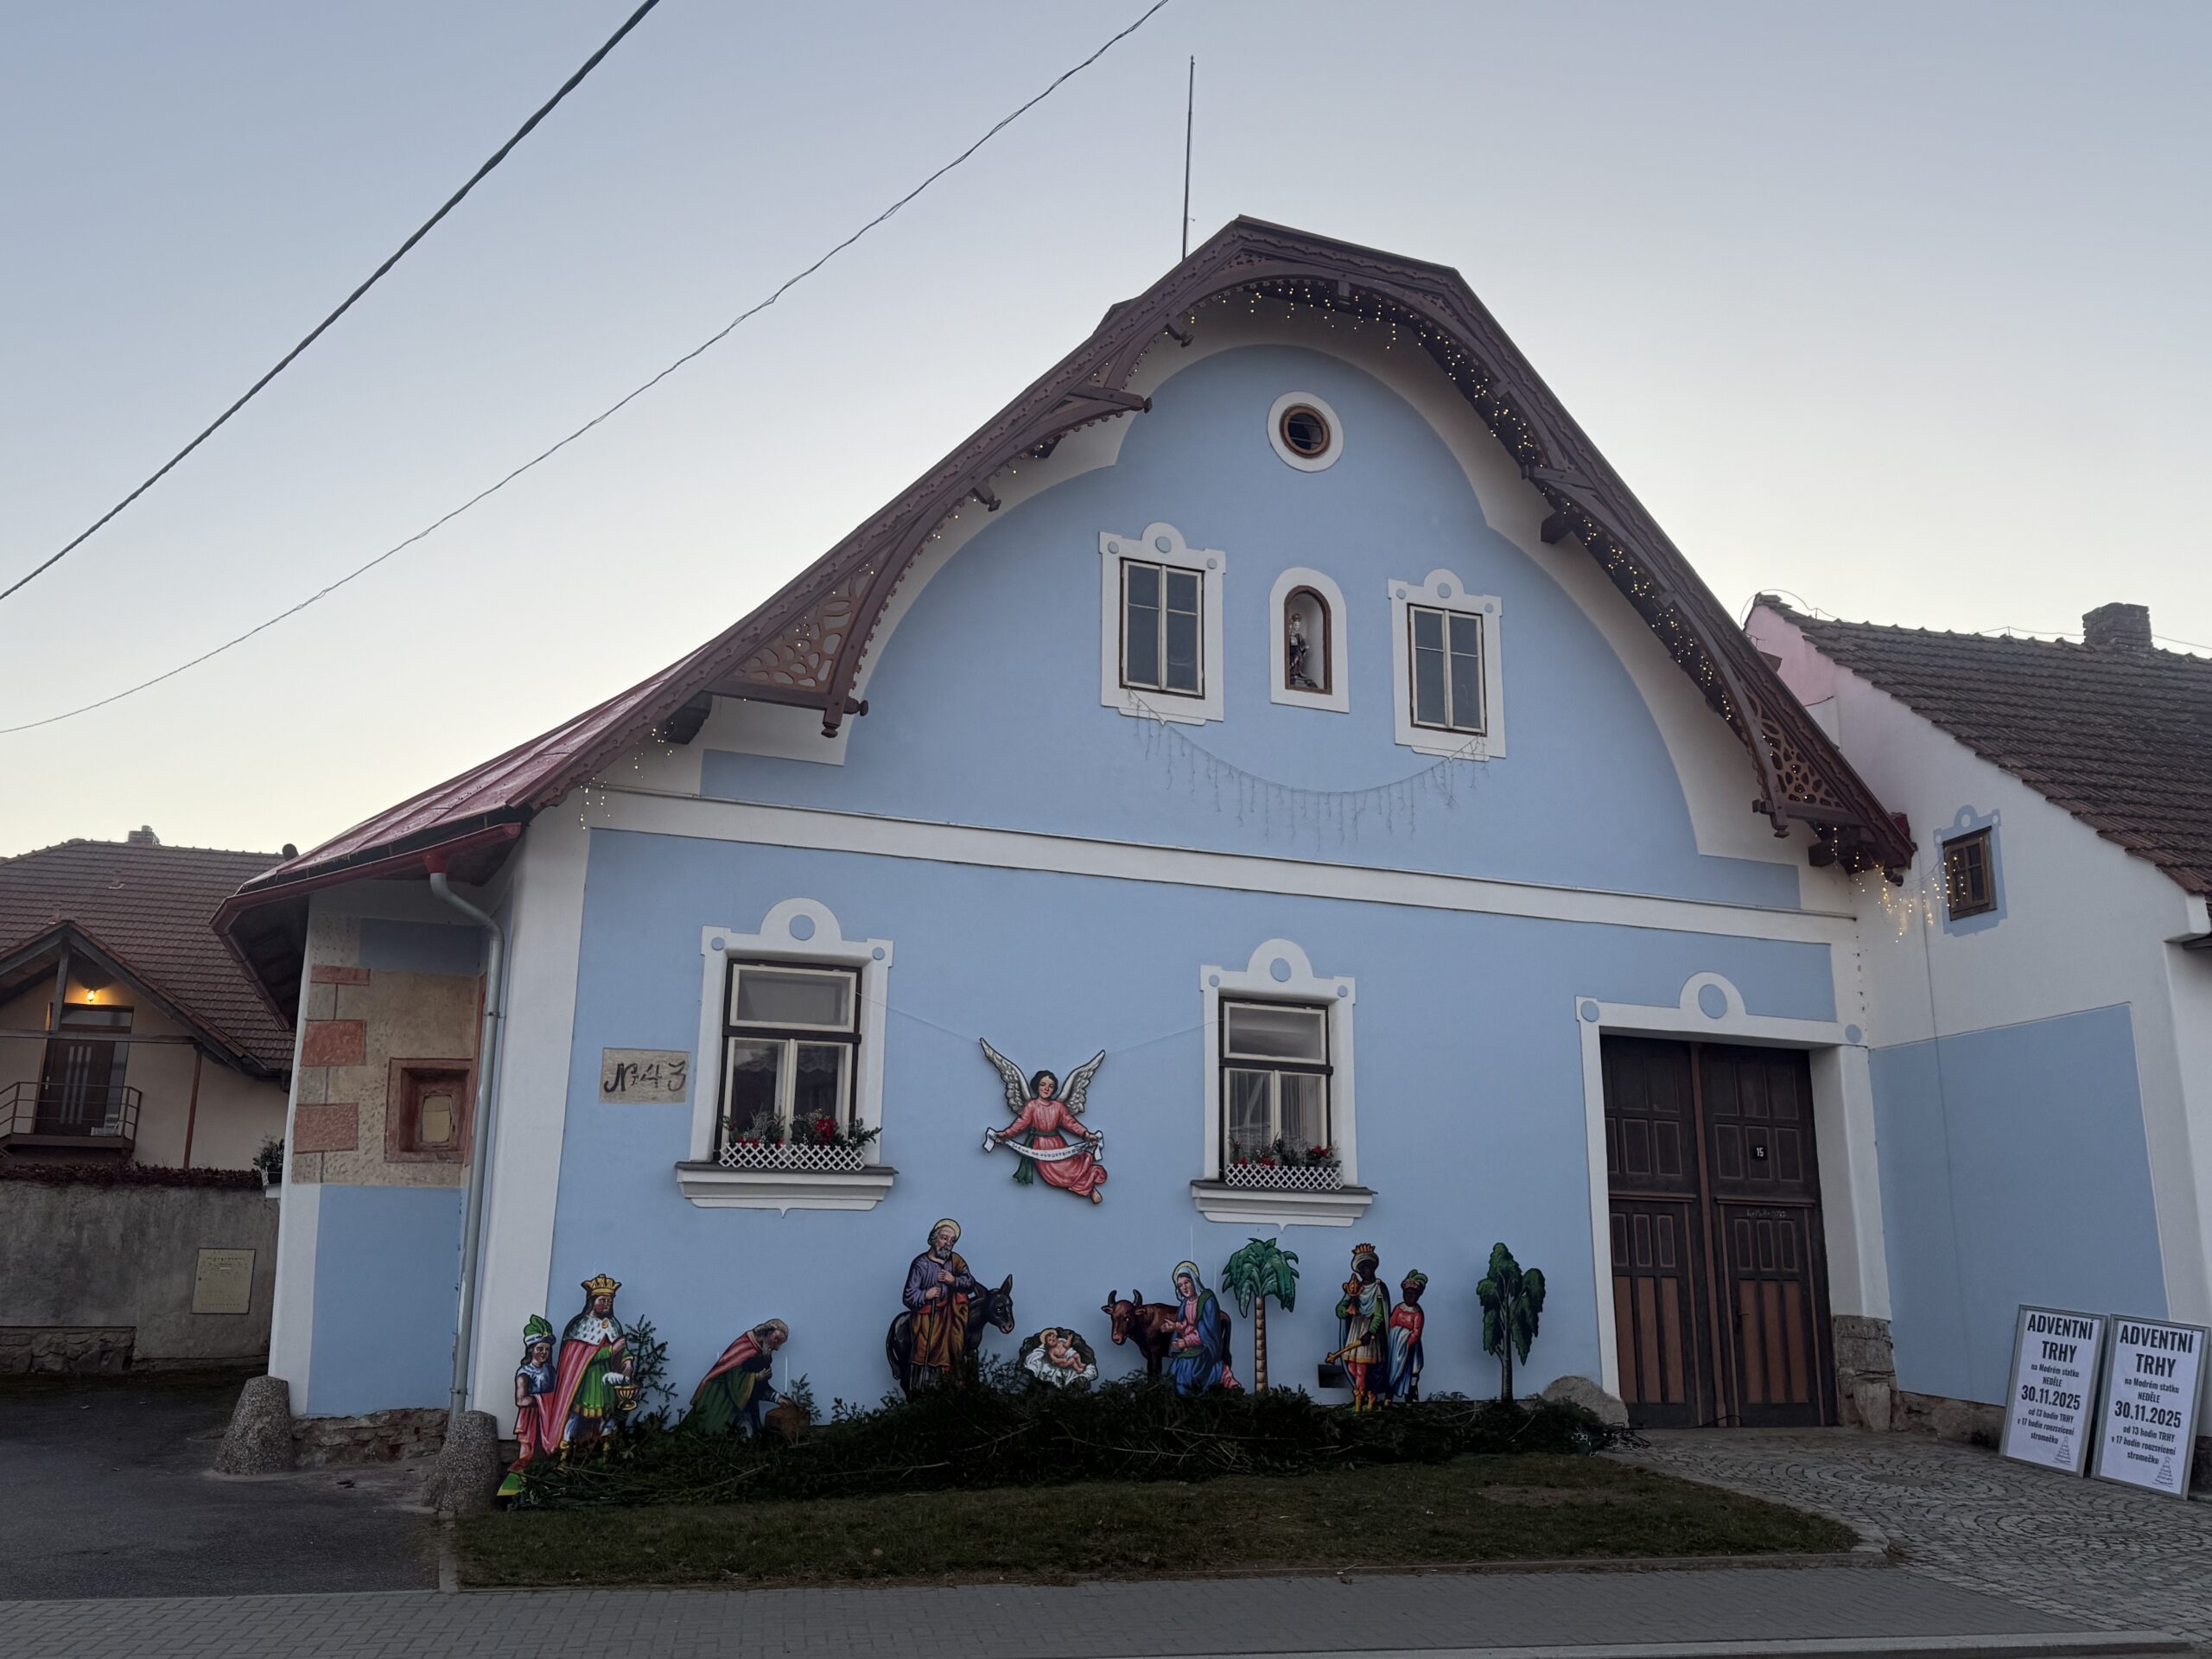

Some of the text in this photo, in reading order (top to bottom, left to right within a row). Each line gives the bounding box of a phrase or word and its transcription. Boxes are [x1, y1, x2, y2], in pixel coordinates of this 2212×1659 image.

[1756, 1147, 1764, 1157] 15
[2027, 1313, 2094, 1339] ADVENTNÍ
[2120, 1325, 2195, 1353] ADVENTNÍ
[2042, 1340, 2077, 1363] TRHY
[2039, 1363, 2061, 1375] Modrém
[2136, 1353, 2177, 1377] TRHY
[2042, 1376, 2063, 1387] NEDĚLE
[2133, 1377, 2158, 1389] Modrém
[2159, 1382, 2179, 1394] statku
[2021, 1384, 2081, 1410] 30.11.2025
[2138, 1391, 2161, 1403] NEDĚLE
[2028, 1408, 2074, 1423] od 13 hodin TRHY
[2114, 1400, 2182, 1428] 30.11.2025
[2022, 1417, 2028, 1426] 17
[2028, 1419, 2043, 1429] hodin
[2116, 1435, 2123, 1444] 17
[2123, 1436, 2140, 1448] hodin
[2123, 1425, 2176, 1443] od 13 hodin TRHY
[2126, 1451, 2159, 1465] stromečku
